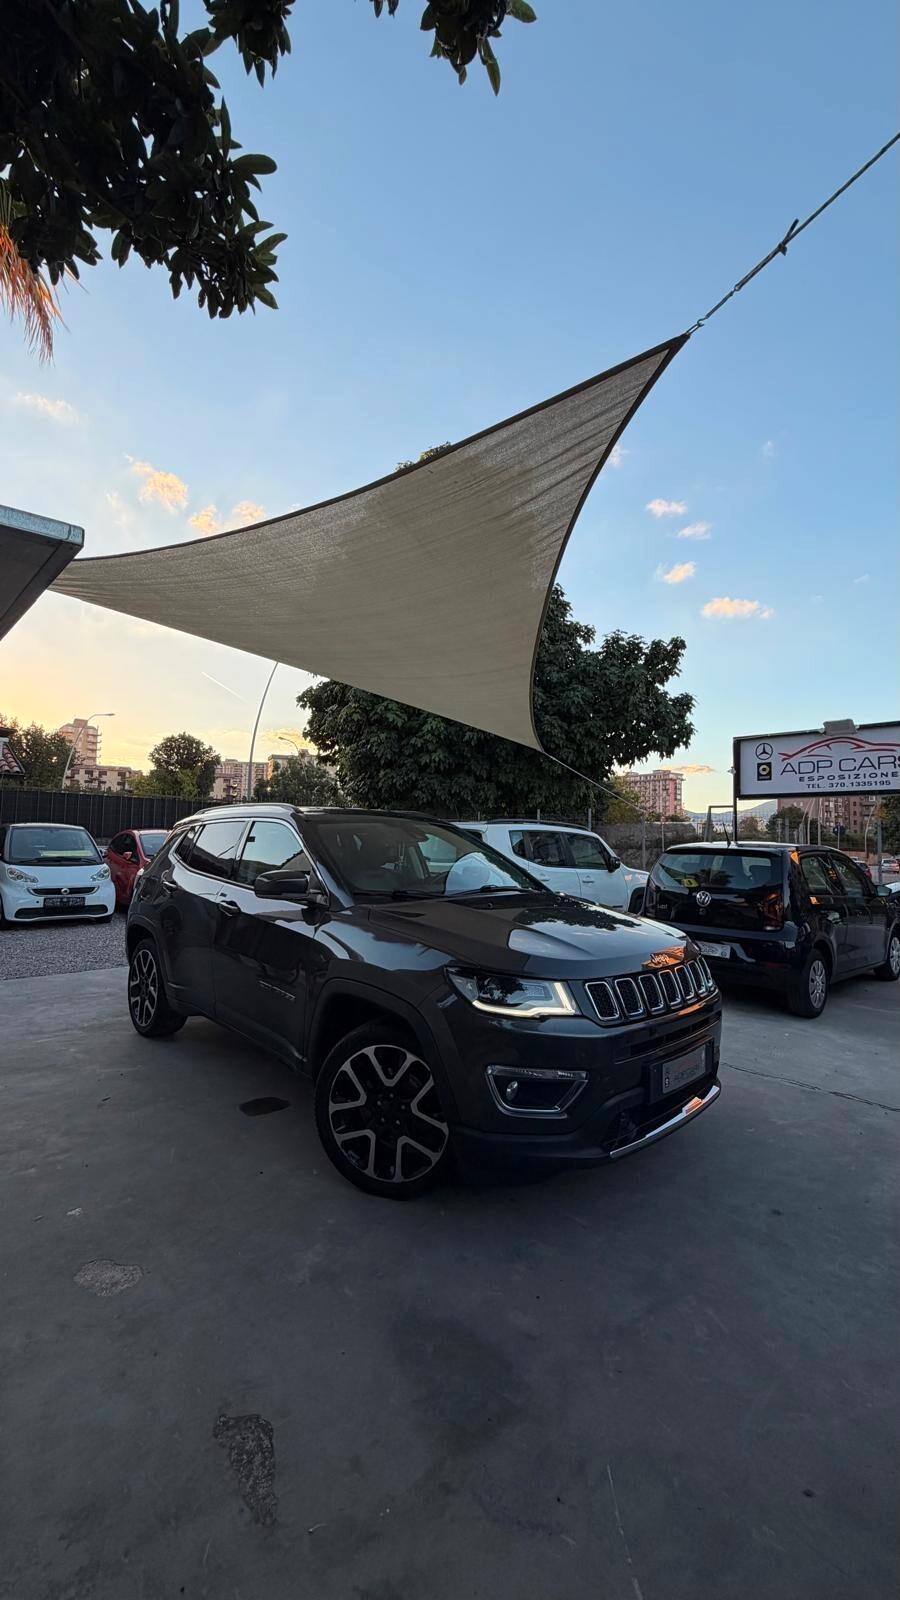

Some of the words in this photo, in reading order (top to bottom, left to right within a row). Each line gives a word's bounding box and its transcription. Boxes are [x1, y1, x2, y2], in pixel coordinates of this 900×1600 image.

[780, 760, 833, 775] ADP
[838, 755, 900, 772] CAR
[799, 771, 899, 782] ESPOSIZIONE
[650, 953, 670, 965] Jeep
